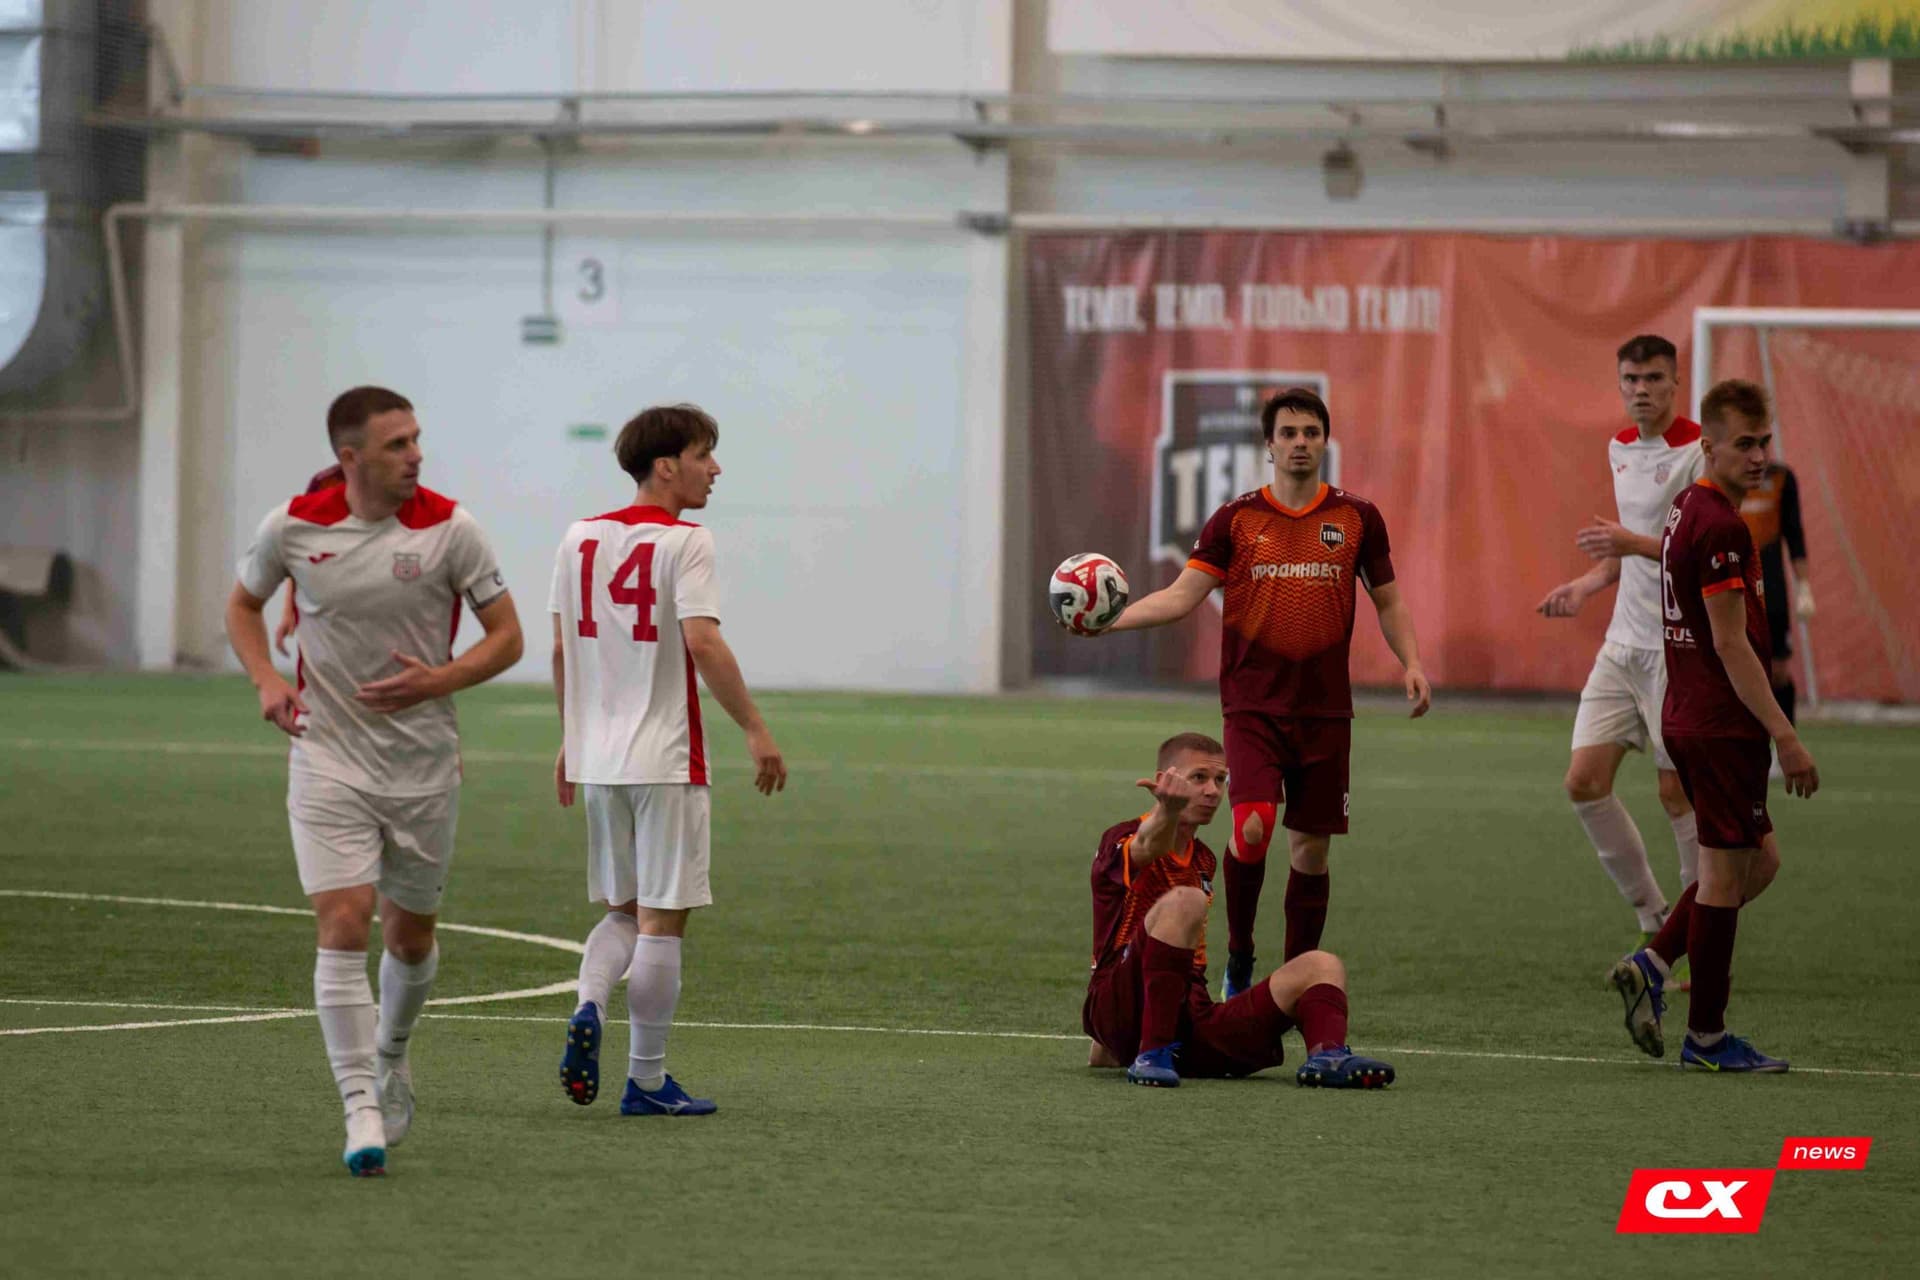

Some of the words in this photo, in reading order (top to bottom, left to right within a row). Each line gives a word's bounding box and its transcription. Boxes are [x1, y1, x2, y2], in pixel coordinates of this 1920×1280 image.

[578, 257, 605, 304] 3
[1322, 530, 1343, 543] ТЕМП
[1251, 561, 1342, 582] ПРОДИНВЕСТ
[577, 538, 659, 643] 14
